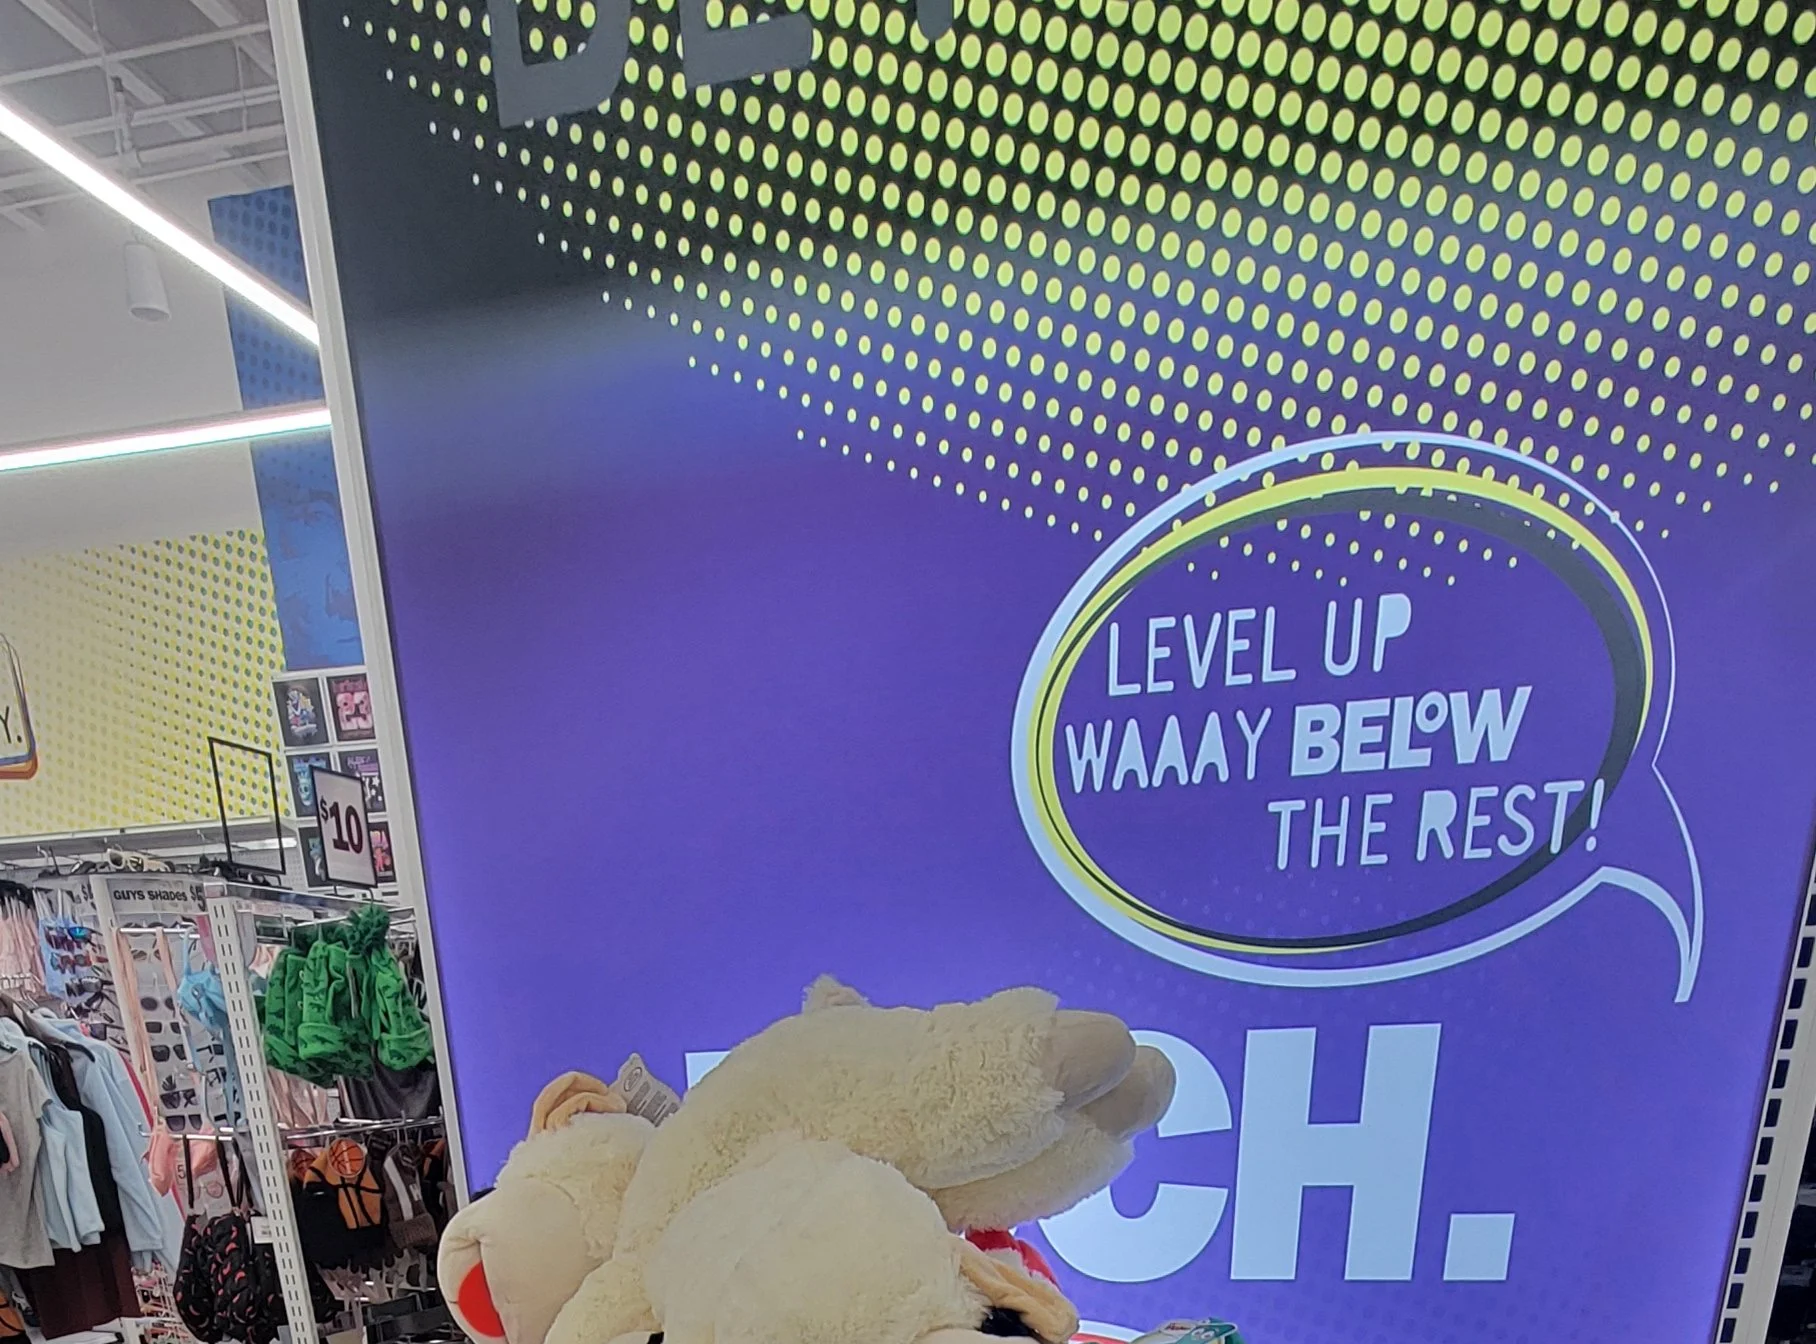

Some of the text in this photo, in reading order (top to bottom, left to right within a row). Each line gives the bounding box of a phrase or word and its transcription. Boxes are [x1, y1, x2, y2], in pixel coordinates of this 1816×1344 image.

[1107, 593, 1413, 698] LEVEL UP
[1064, 706, 1273, 795] WAAAY
[319, 795, 364, 854] $10
[1266, 778, 1606, 871] THE REST!
[113, 888, 146, 901] GUYS
